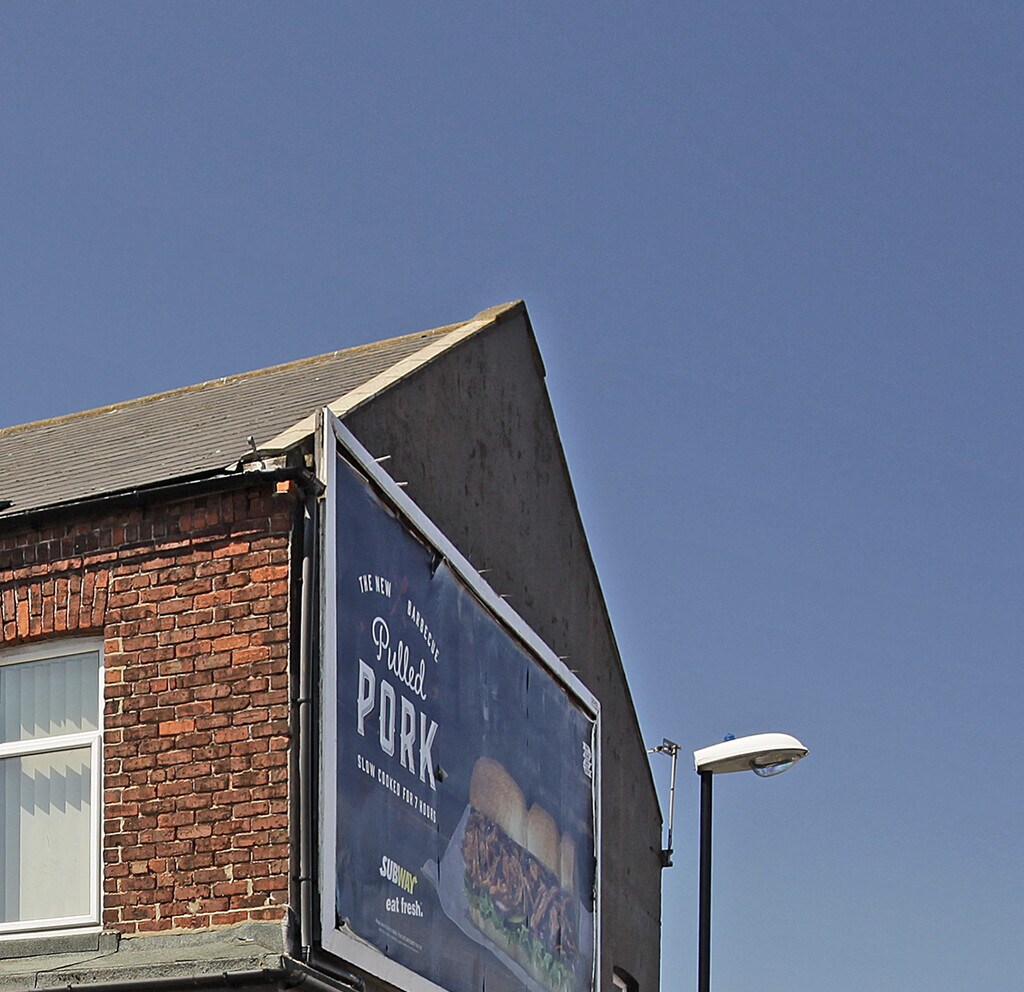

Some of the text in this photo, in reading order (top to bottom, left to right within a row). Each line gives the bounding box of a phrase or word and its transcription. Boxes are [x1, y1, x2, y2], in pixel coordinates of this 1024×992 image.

[358, 574, 440, 663] THE NEW BARBECUE
[372, 616, 427, 701] Pulled
[357, 659, 439, 791] PORK
[357, 754, 376, 778] SLOW
[378, 768, 401, 797] COOKED
[402, 787, 414, 809] FOR
[419, 802, 437, 824] HOURS
[379, 855, 417, 895] SUBWAY
[385, 897, 400, 913] eat
